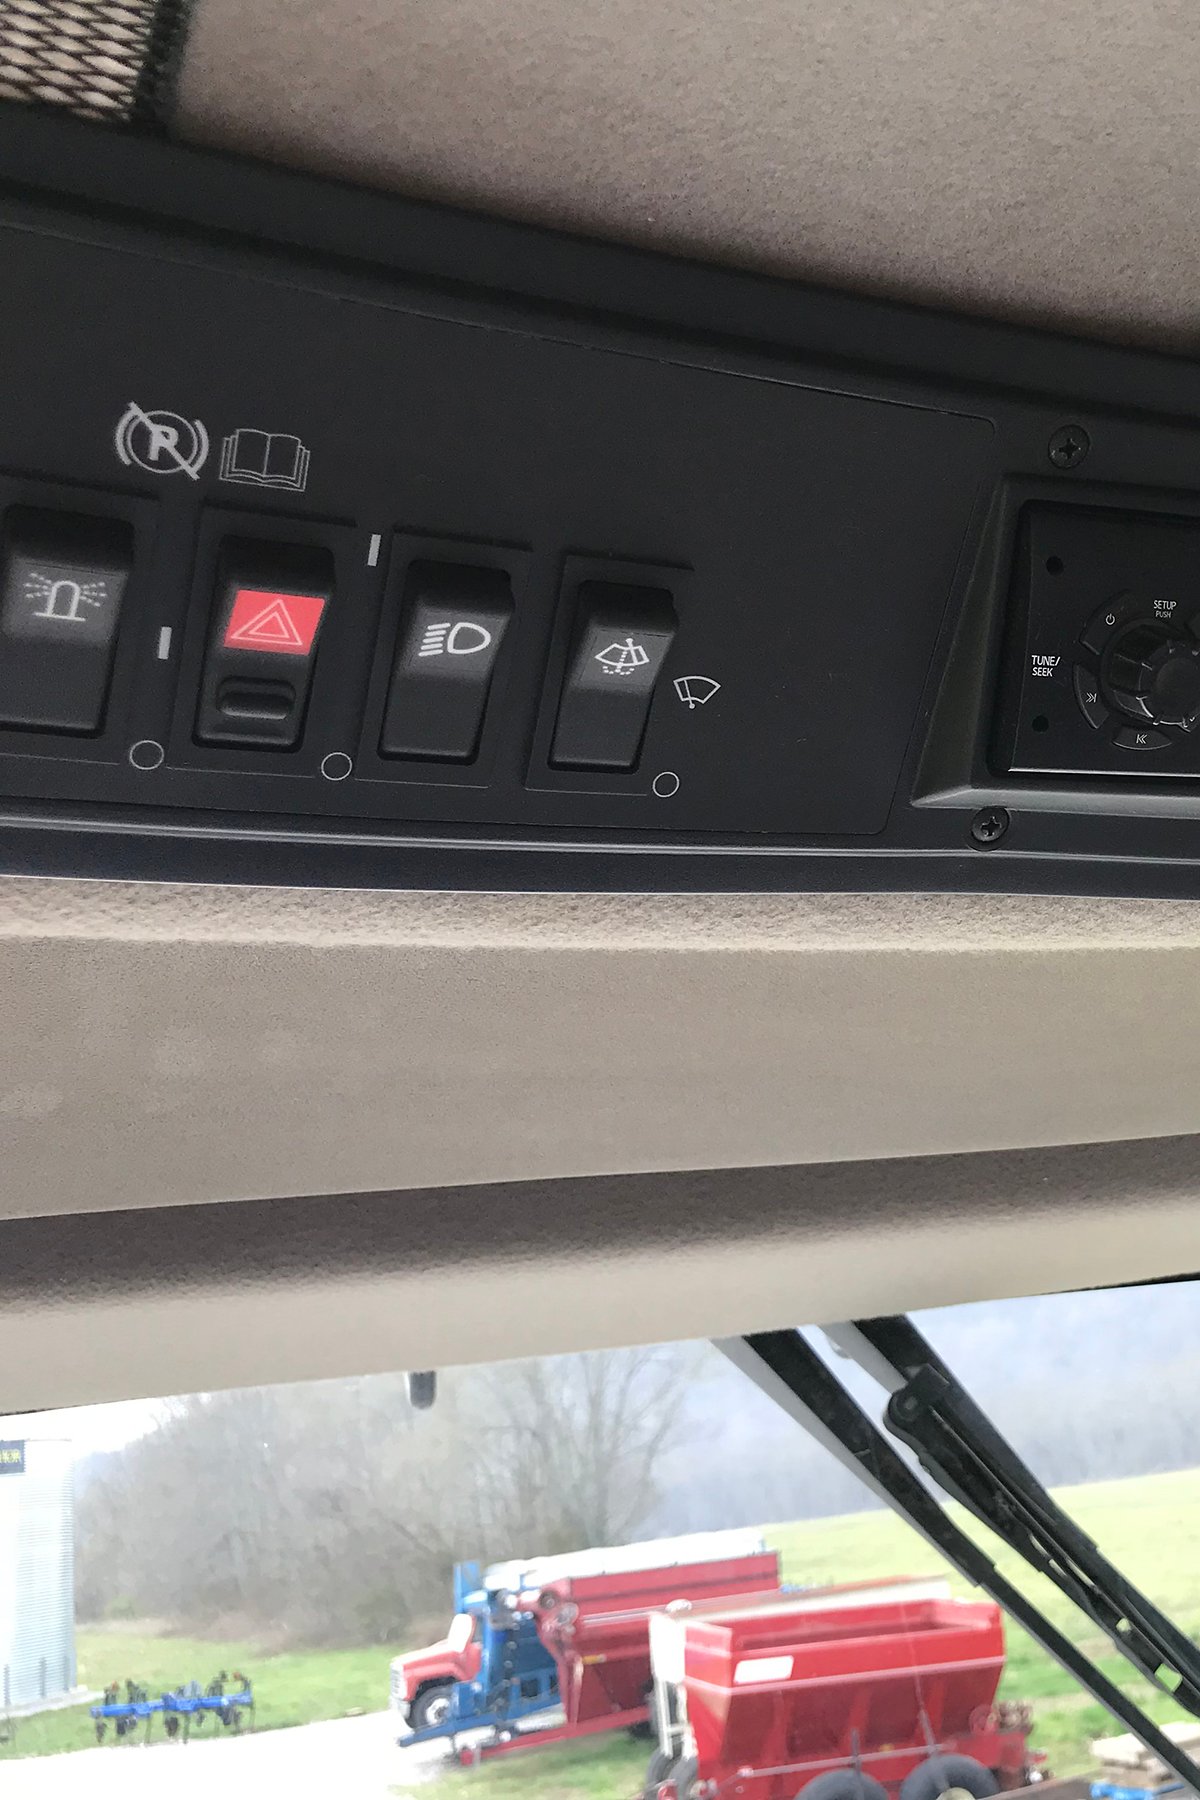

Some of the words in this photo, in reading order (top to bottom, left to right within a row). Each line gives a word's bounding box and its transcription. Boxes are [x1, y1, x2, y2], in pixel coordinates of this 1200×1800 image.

[1153, 600, 1177, 610] SETUP
[1031, 654, 1061, 666] TUNE/
[1031, 667, 1054, 677] SEEK
